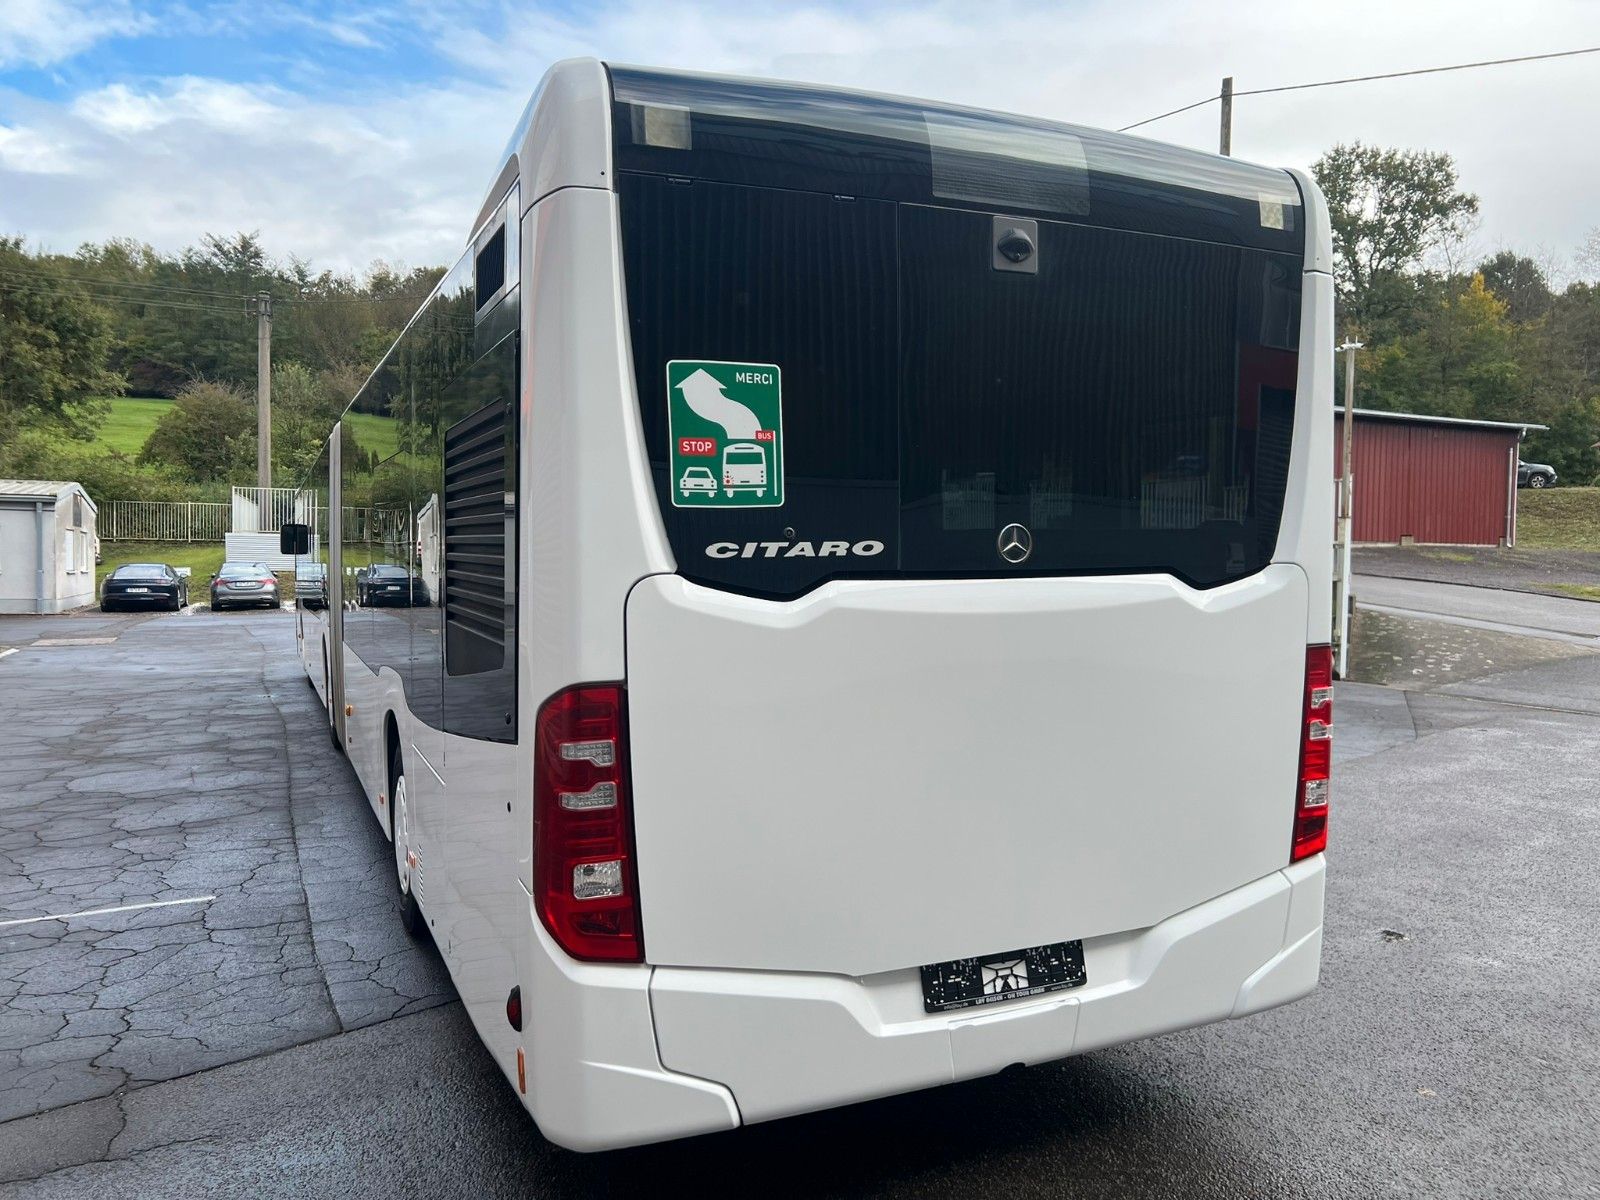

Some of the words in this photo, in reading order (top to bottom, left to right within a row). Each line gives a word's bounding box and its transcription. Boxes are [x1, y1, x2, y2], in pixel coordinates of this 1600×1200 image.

[735, 372, 773, 385] MERCI
[757, 432, 772, 440] BUS
[682, 441, 712, 452] STOP
[705, 540, 885, 559] CITARO
